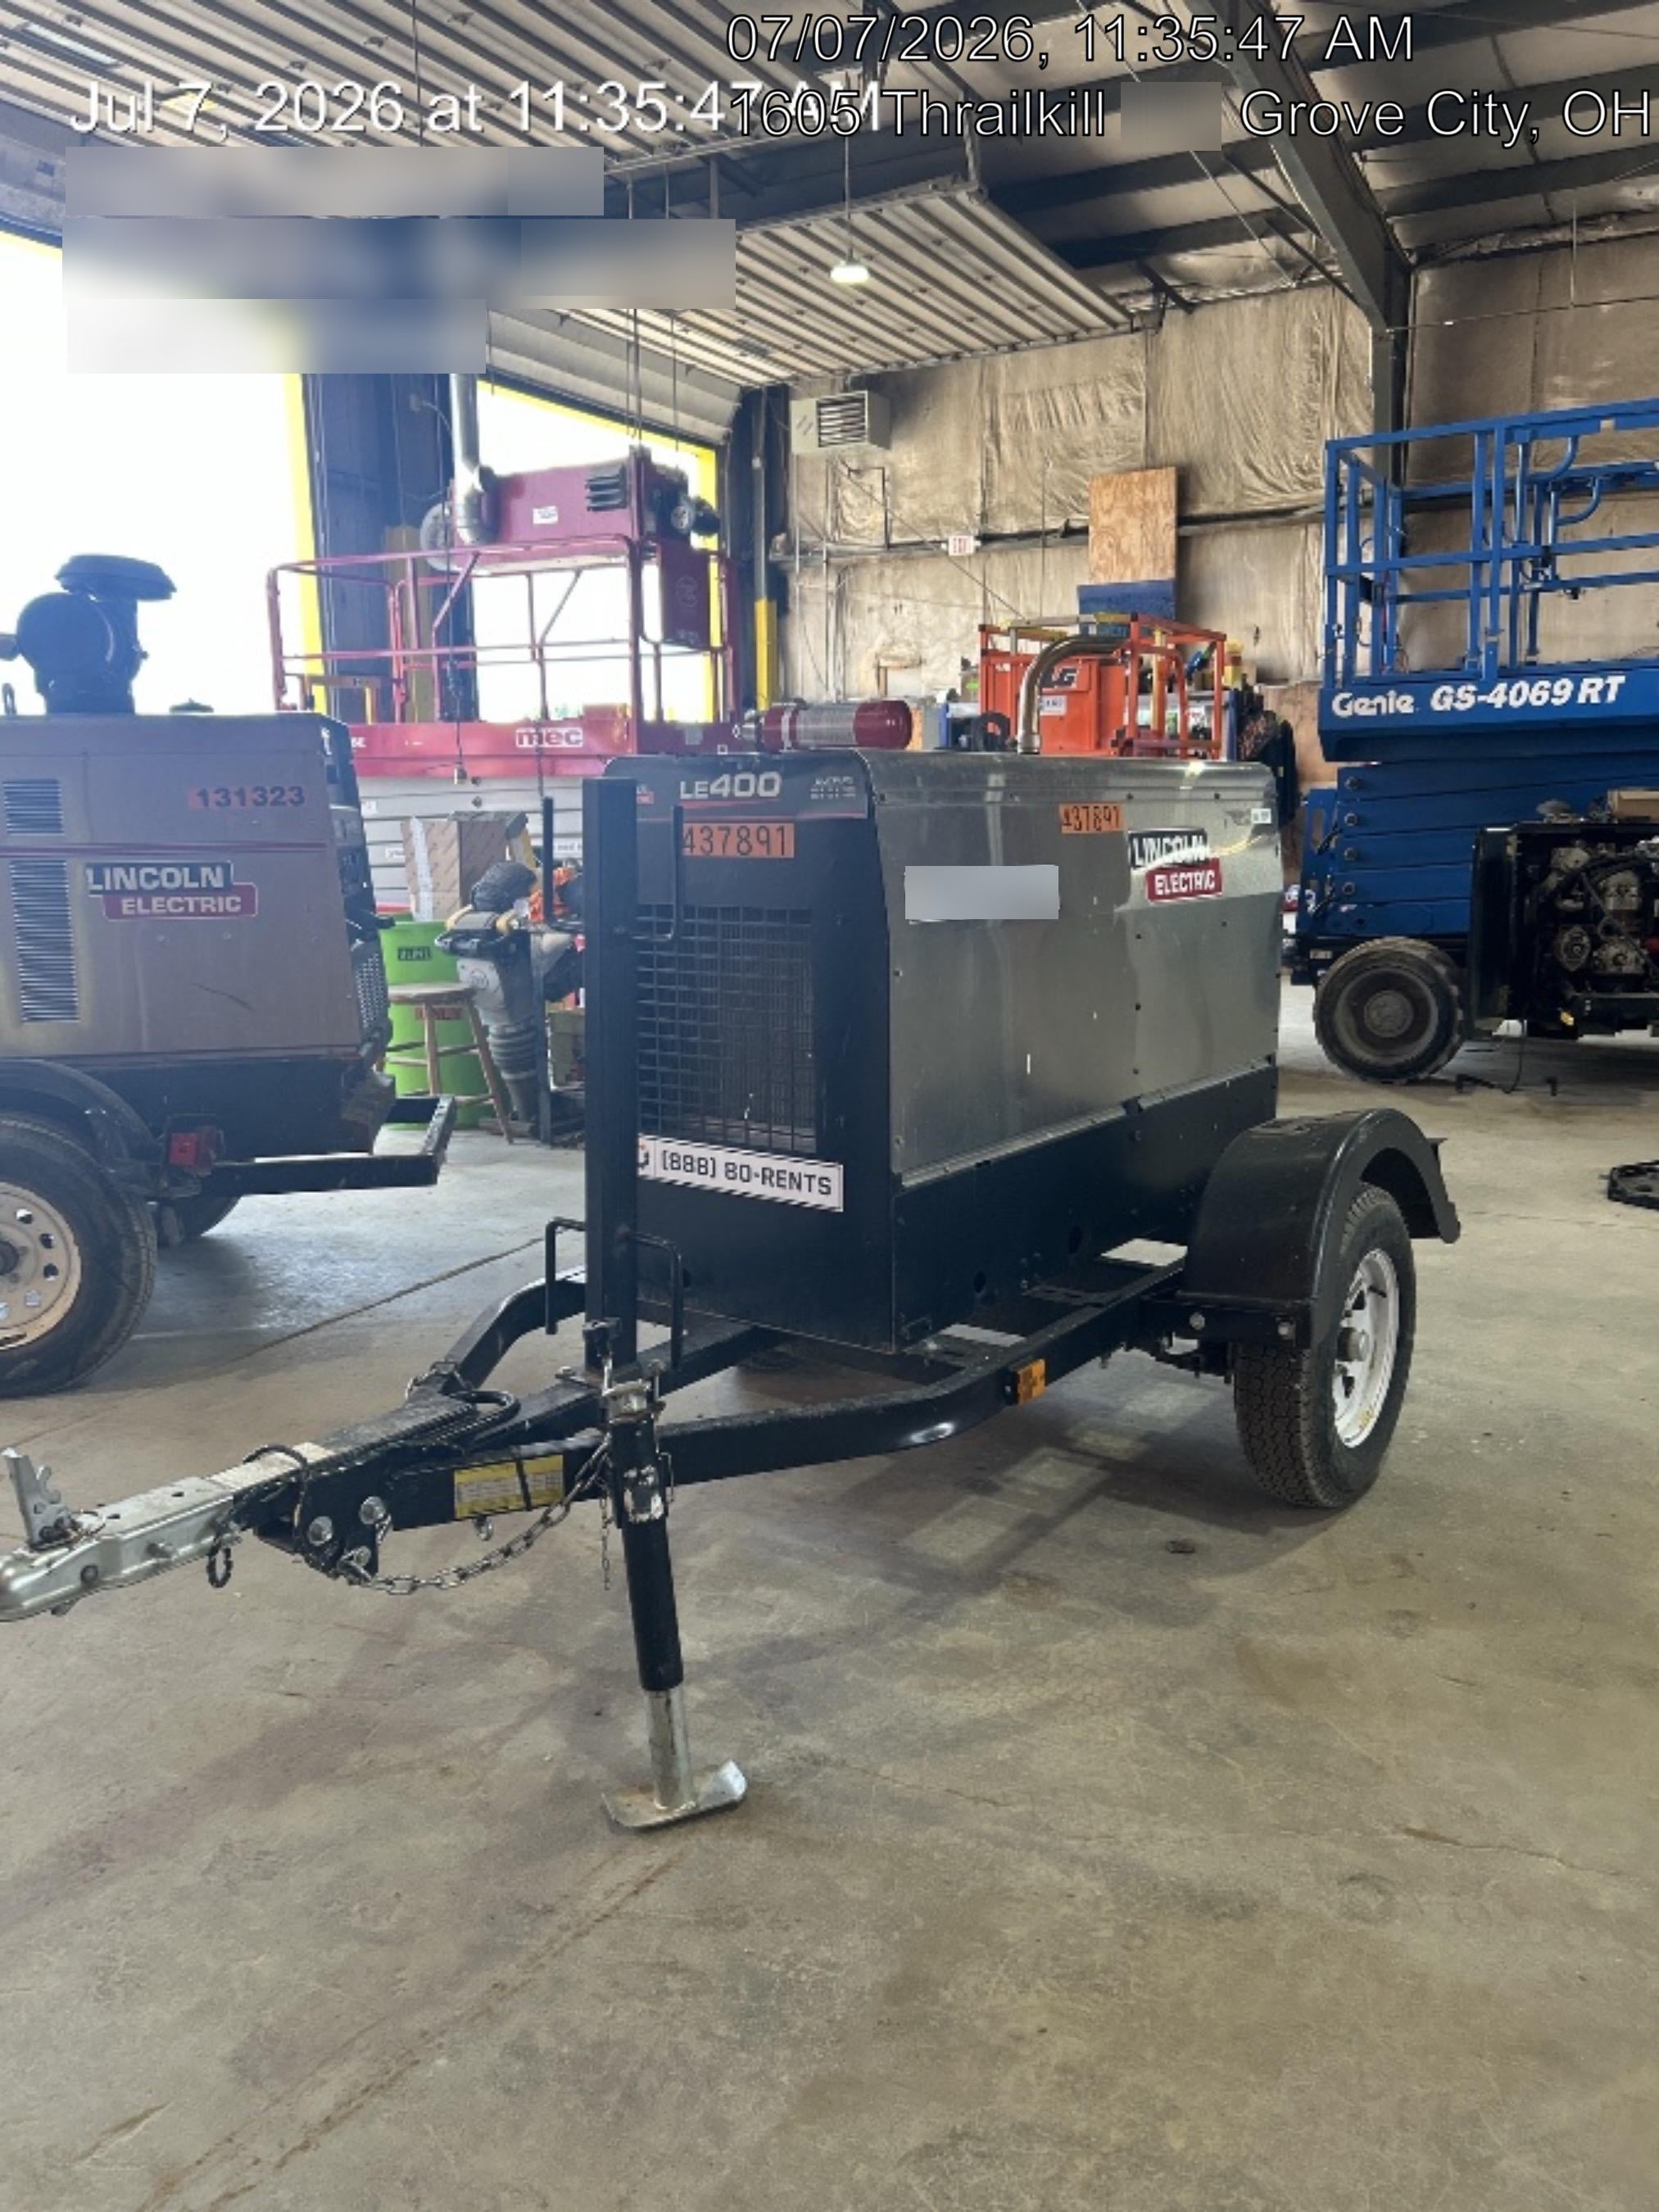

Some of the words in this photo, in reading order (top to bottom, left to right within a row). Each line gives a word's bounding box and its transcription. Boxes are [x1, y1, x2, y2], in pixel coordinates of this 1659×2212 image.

[1331, 690, 1415, 718] Genie
[1430, 678, 1575, 712] GS-4069
[1576, 675, 1626, 704] RT
[196, 785, 306, 808] 131323
[680, 772, 782, 800] LE400
[682, 825, 786, 857] 437891
[1132, 835, 1207, 866] LINCOLN
[85, 865, 224, 891] LINCOLN
[1154, 869, 1216, 895] ELECTRIC
[120, 895, 242, 916] ELECTRIC
[724, 1162, 832, 1195] 80-RENTS
